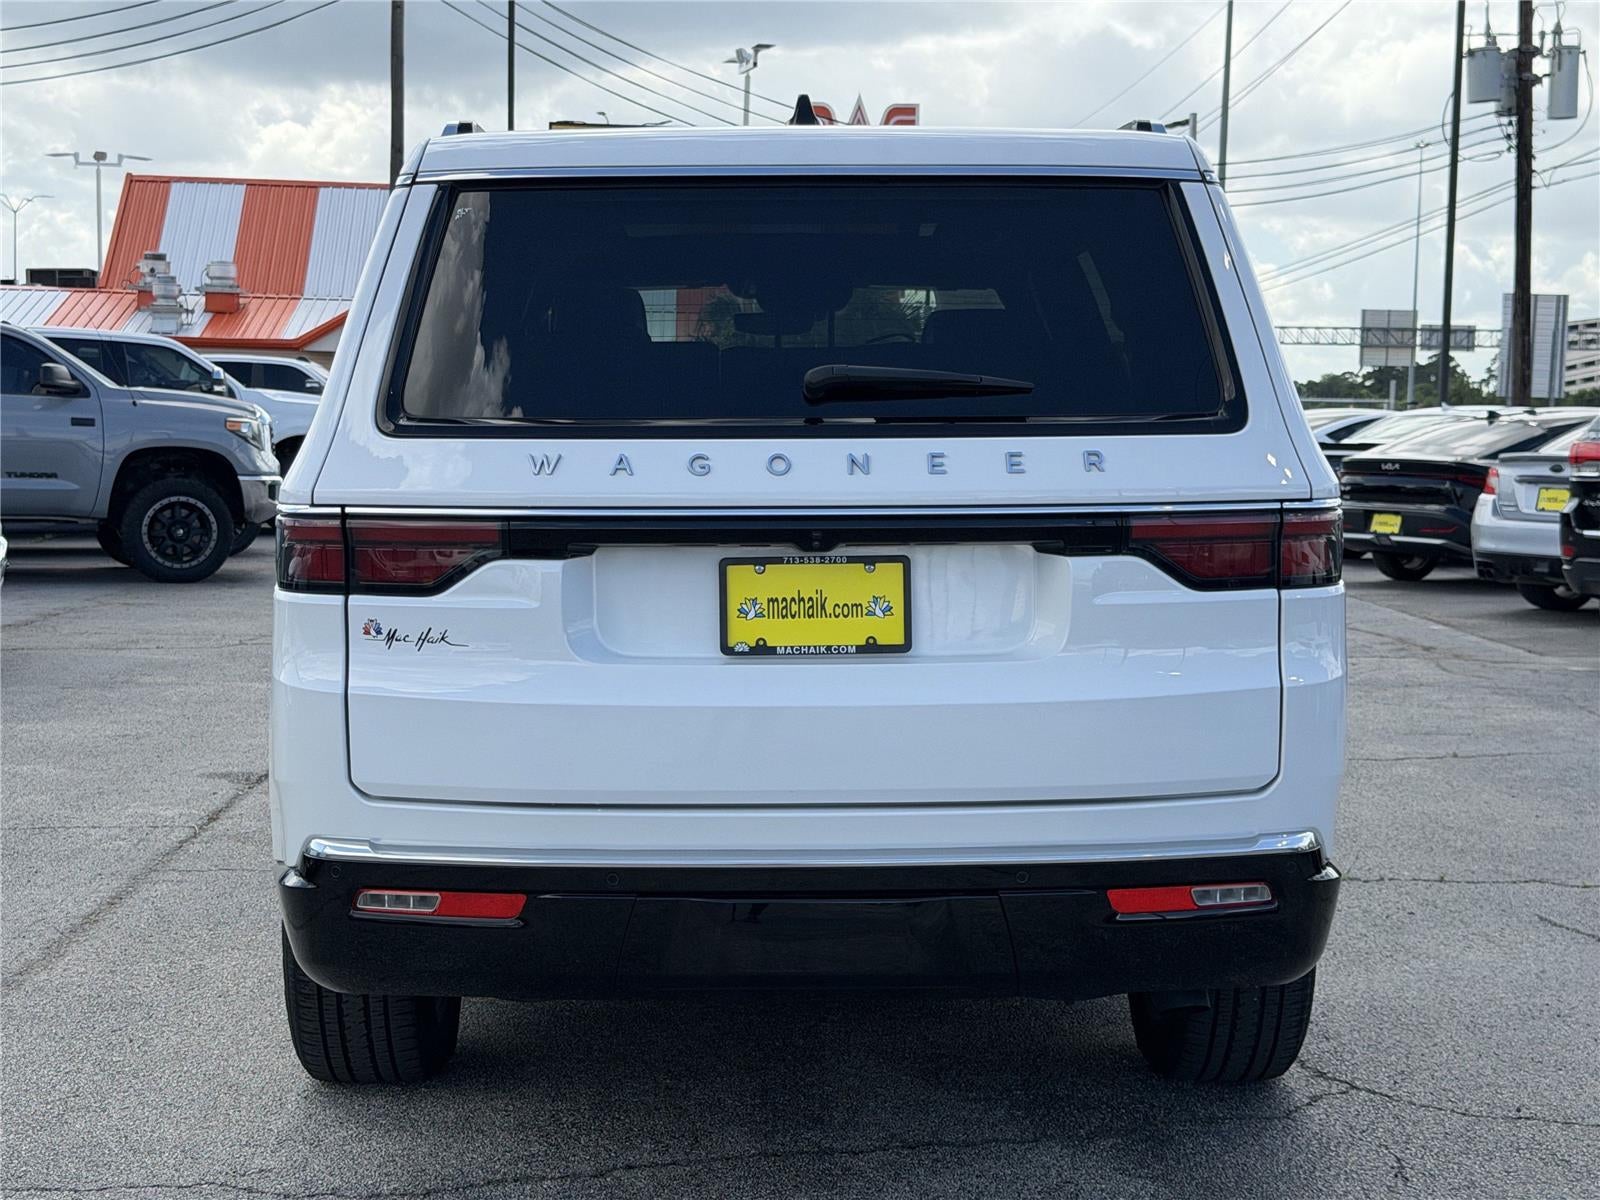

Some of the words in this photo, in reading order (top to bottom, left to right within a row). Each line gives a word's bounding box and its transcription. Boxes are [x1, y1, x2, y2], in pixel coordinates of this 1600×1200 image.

[528, 450, 1106, 476] WAGONEER
[782, 556, 848, 564] 713-538-2700
[767, 589, 864, 619] machaik.com
[374, 627, 414, 650] Mac
[415, 626, 468, 652] Haik
[776, 645, 856, 655] MACHAIK.COM
